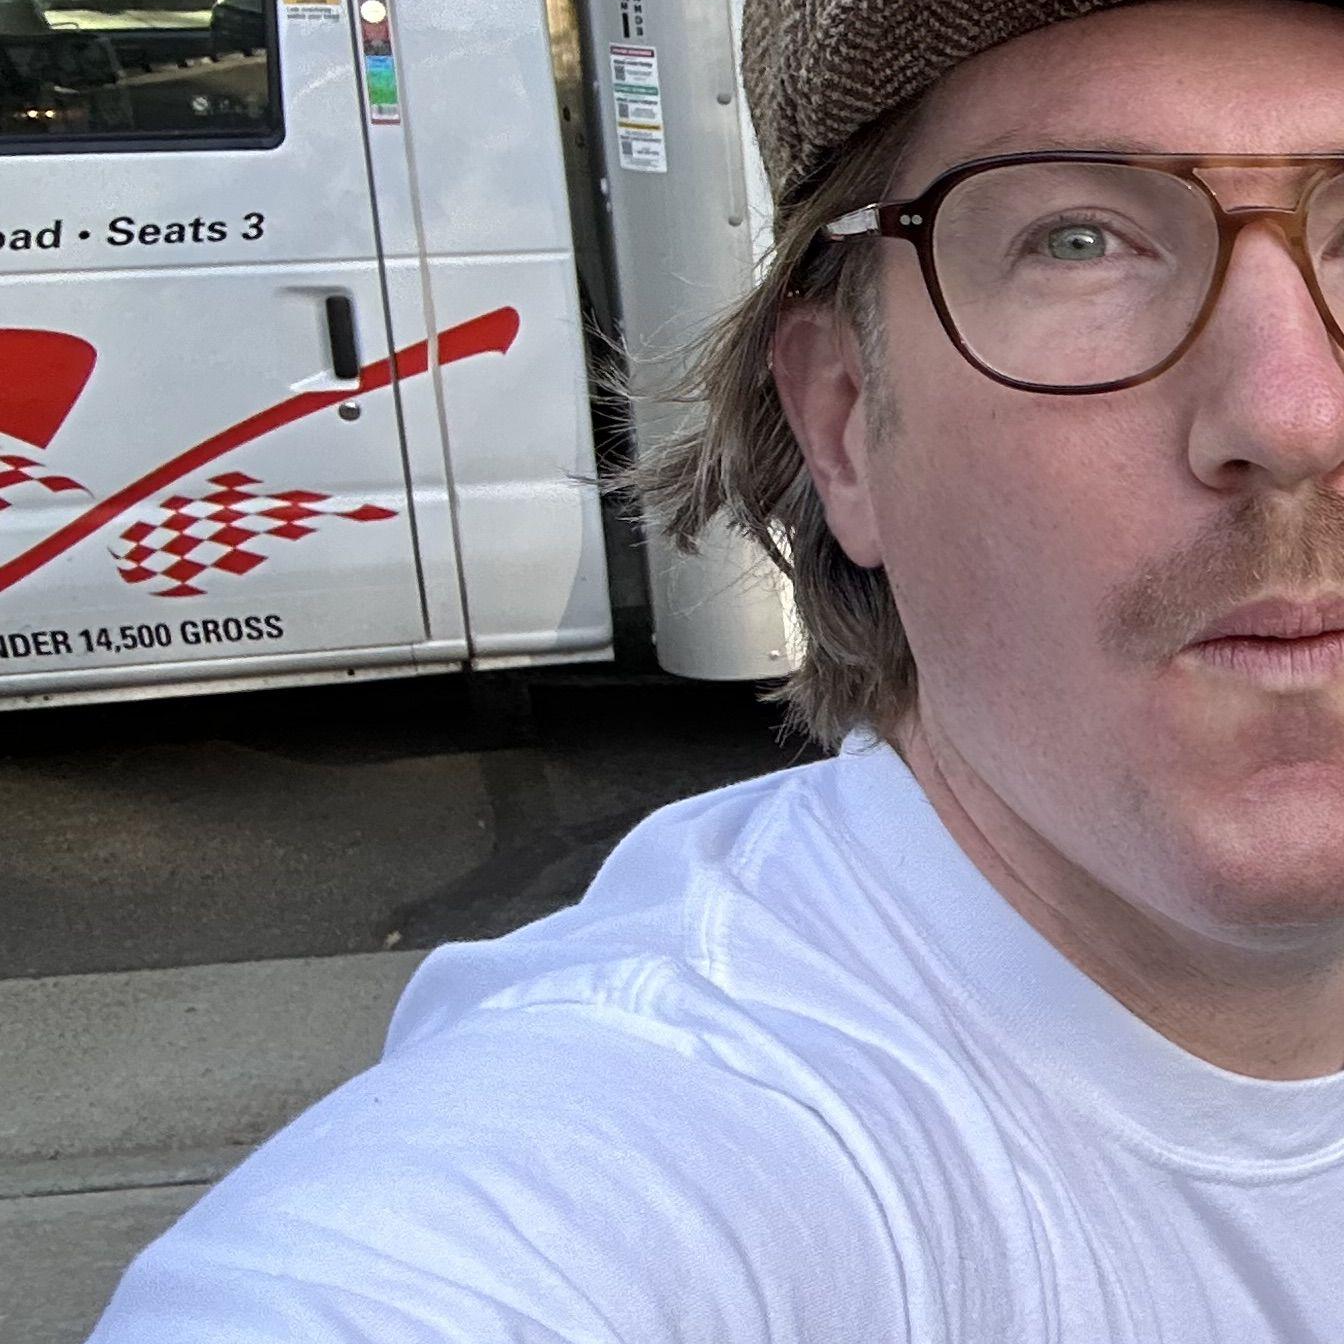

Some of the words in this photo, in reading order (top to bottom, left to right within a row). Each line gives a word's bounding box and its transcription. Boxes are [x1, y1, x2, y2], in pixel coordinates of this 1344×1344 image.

[0, 218, 63, 250] ad
[106, 216, 228, 246] Seats
[241, 212, 265, 241] 3
[79, 623, 172, 654] 14,500
[180, 615, 284, 645] GROSS
